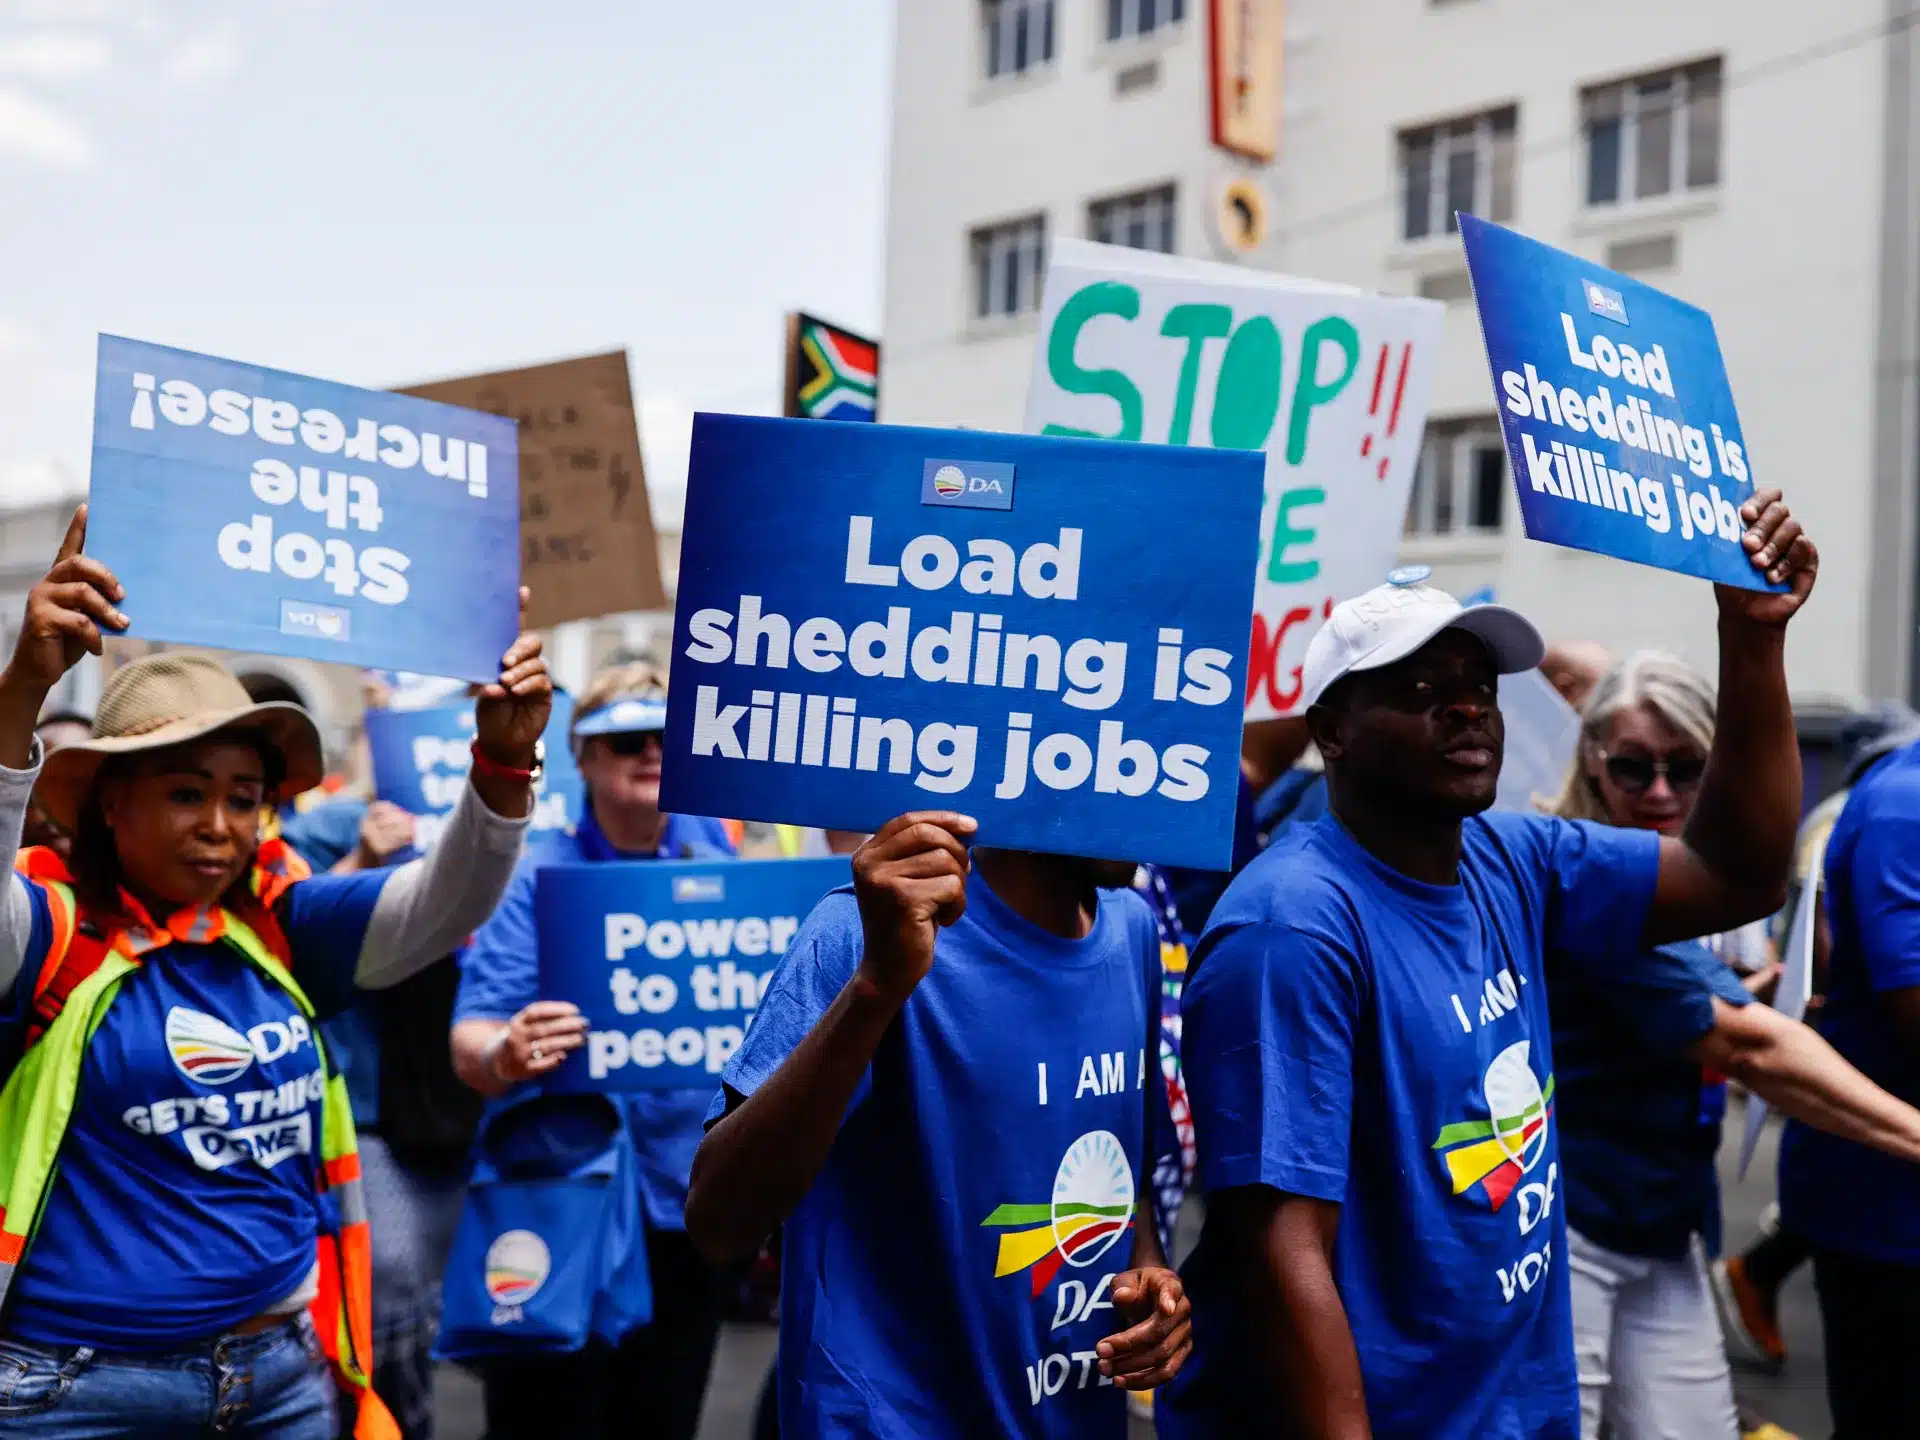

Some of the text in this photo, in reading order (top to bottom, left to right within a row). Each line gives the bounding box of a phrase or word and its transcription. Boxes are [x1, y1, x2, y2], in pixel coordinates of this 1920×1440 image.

[1560, 312, 1676, 398] Load
[130, 372, 489, 499] increase!
[1501, 363, 1749, 483] shedding is
[249, 458, 383, 532] the
[968, 477, 1004, 495] DA
[1521, 433, 1671, 534] killing
[217, 514, 411, 605] Stop
[845, 515, 1083, 600] Load
[684, 594, 1128, 711] shedding
[1153, 628, 1234, 707] is
[691, 685, 1211, 802] killing jobs
[604, 912, 799, 961] Power
[609, 967, 679, 1015] to
[1451, 994, 1472, 1033] I
[247, 1015, 313, 1065] DA
[588, 1013, 754, 1080] peop
[1038, 1063, 1048, 1105] I
[1075, 1051, 1124, 1099] AM
[122, 1094, 230, 1136] GETS
[1050, 1273, 1117, 1331] DA
[1026, 1351, 1114, 1406] VOT
